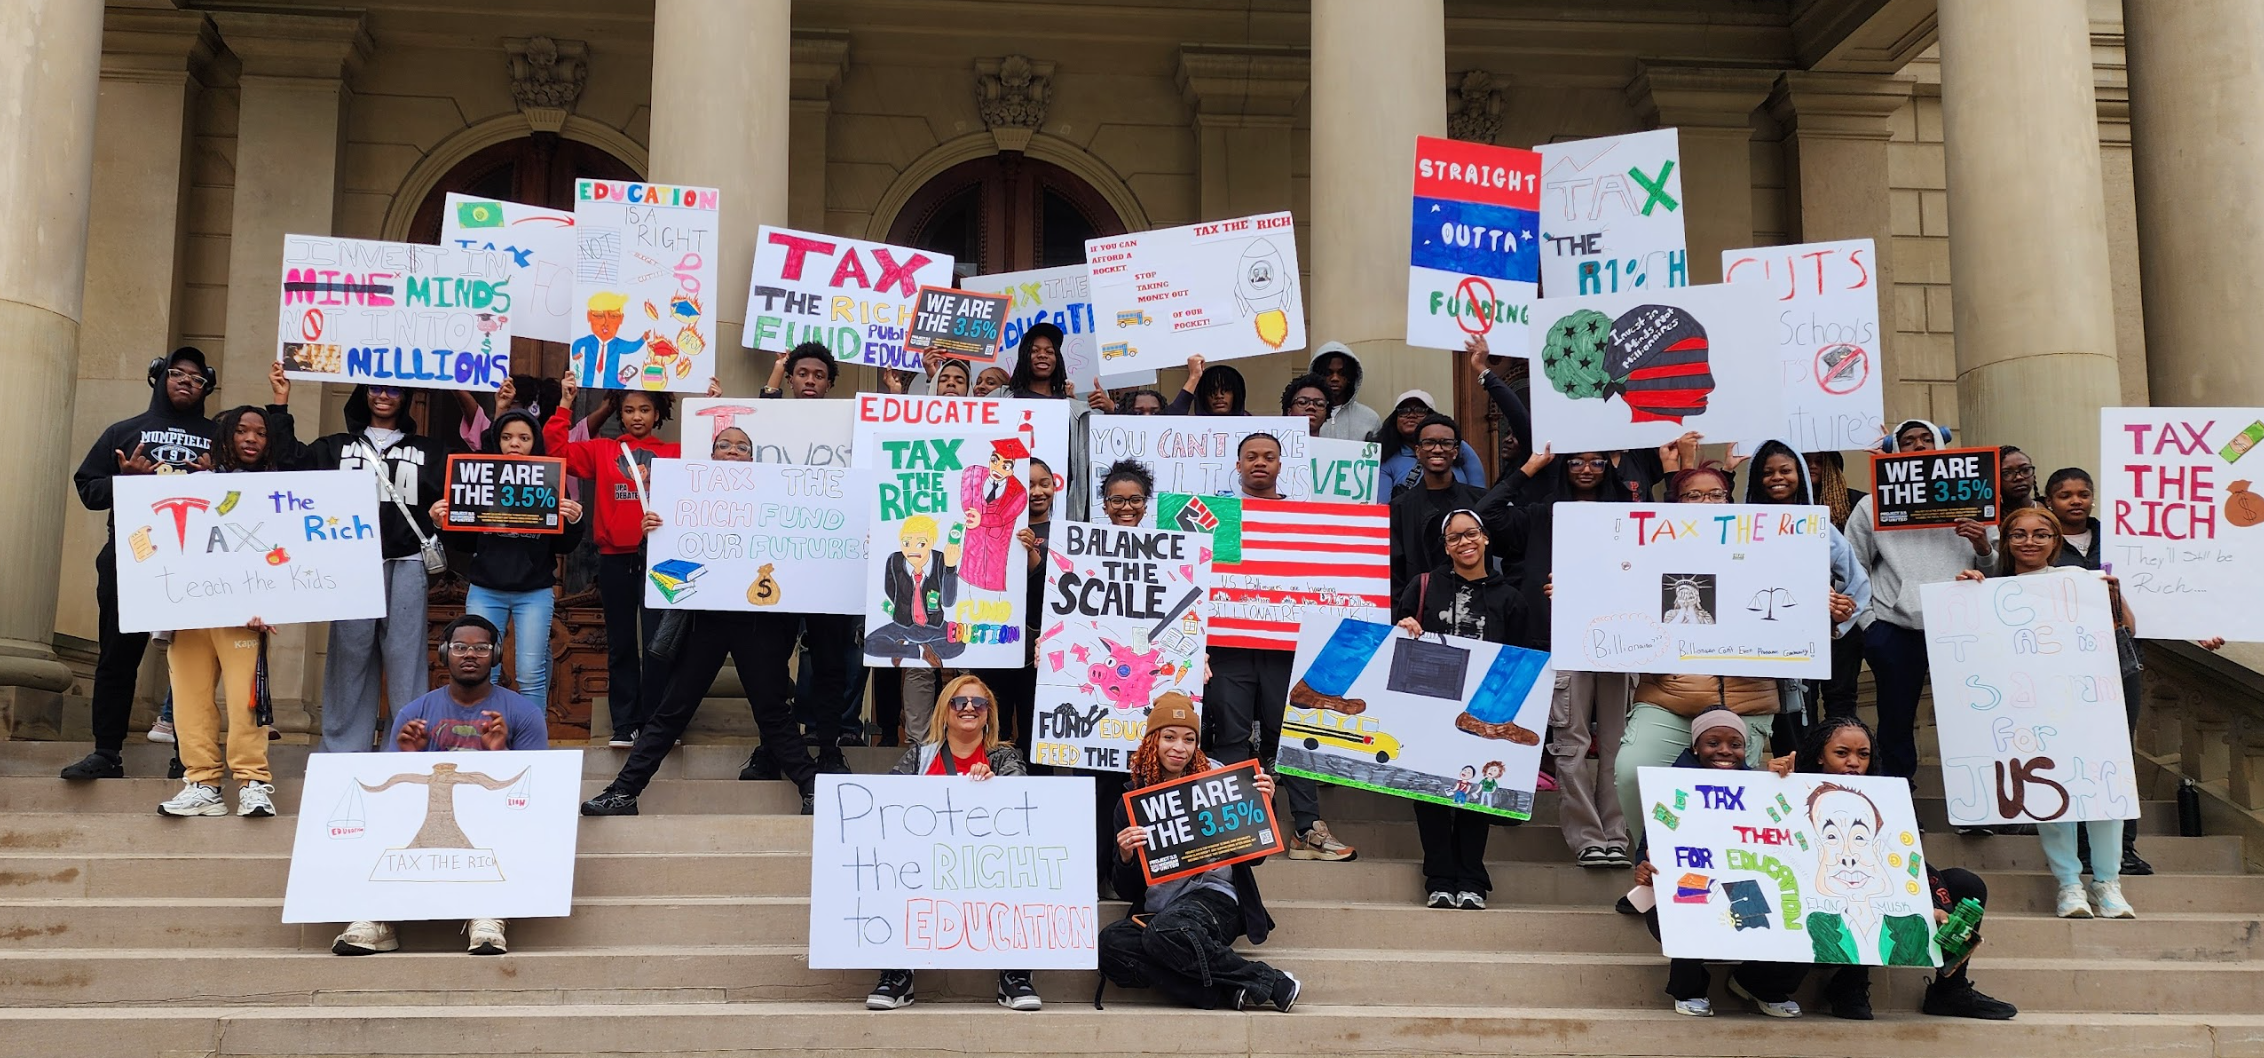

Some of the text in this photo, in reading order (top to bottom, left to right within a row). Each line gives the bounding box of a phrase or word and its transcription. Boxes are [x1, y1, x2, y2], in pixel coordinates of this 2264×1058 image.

[1419, 159, 1536, 194] STRAIGHT
[1547, 159, 1680, 221] TAX
[579, 182, 717, 210] EDUCATION
[625, 206, 657, 225] IS A
[1194, 216, 1291, 237] TAX THE RICH
[579, 233, 611, 260] NOT
[638, 224, 708, 252] RIGHT
[1100, 242, 1118, 251] YOU
[1119, 240, 1137, 248] CAN
[1441, 222, 1517, 253] OUTTA
[1549, 232, 1603, 256] THE
[459, 248, 508, 278] IN
[768, 232, 933, 299] TAX
[1091, 253, 1124, 264] AFFORD
[1092, 265, 1127, 275] ROCKET
[284, 268, 511, 313] MINE MINDS
[1044, 275, 1088, 298] THE
[1135, 271, 1157, 280] STOP
[1136, 281, 1169, 292] TAKING
[754, 285, 914, 326] THE RICH
[927, 293, 995, 319] WE ARE
[1137, 289, 1189, 303] MONEY OUT
[1430, 291, 1529, 325] FUNDING
[280, 308, 474, 351] NOT INTO
[753, 315, 861, 360] FUND
[917, 312, 952, 333] THE
[953, 317, 997, 340] 3.5%
[1174, 319, 1210, 330] POCKET!
[1609, 309, 1659, 346] Invest in
[1624, 307, 1674, 353] Minds Not
[1780, 310, 1873, 346] Schools
[1622, 317, 1679, 369] Millionaires
[347, 347, 509, 388] MILLIONS
[860, 397, 1000, 424] EDUCATE
[1091, 427, 1146, 457] YOU
[1157, 427, 1229, 458] CAN'T
[2124, 420, 2216, 455] TAX
[882, 438, 964, 472] TAX
[1885, 456, 1980, 483] WE ARE
[459, 462, 545, 486] WE ARE
[685, 463, 845, 499] TAX THE
[897, 472, 944, 492] THE
[2124, 465, 2214, 503] THE
[451, 483, 556, 509] THE 3.5%
[879, 483, 948, 522] RICH
[1878, 479, 1993, 505] THE 3.5%
[151, 497, 271, 555] TAX
[304, 514, 374, 542] Rich
[675, 499, 845, 531] RICH FUND
[1630, 511, 1699, 546] TAX
[1714, 512, 1768, 545] THE
[2115, 500, 2216, 540] RICH
[678, 532, 743, 559] OUR
[1067, 526, 1185, 560] BALANCE
[2115, 545, 2175, 569] They'll
[2217, 550, 2232, 563] be
[243, 570, 276, 595] the
[290, 564, 337, 591] Kids
[1102, 561, 1159, 584] THE
[1221, 575, 1237, 589] US
[955, 599, 1012, 622] FUND
[1050, 572, 1167, 619] SCALE
[1039, 708, 1096, 738] FUND
[1036, 743, 1080, 765] FEED
[1084, 746, 1119, 767] THE
[1140, 790, 1185, 823] WE
[1191, 775, 1242, 811] ARE
[1695, 785, 1746, 811] TAX
[836, 783, 1038, 844] Protect
[1145, 816, 1194, 851] THE
[1198, 799, 1265, 837] 3.5%
[1733, 826, 1793, 846] THEM
[386, 854, 497, 871] TAX THE RICH
[843, 842, 1069, 891] the RIGHT
[1674, 846, 1803, 930] FOR EDUCATION
[1806, 896, 1911, 913] ELON MUSK
[843, 897, 1096, 952] to EDUCATION
